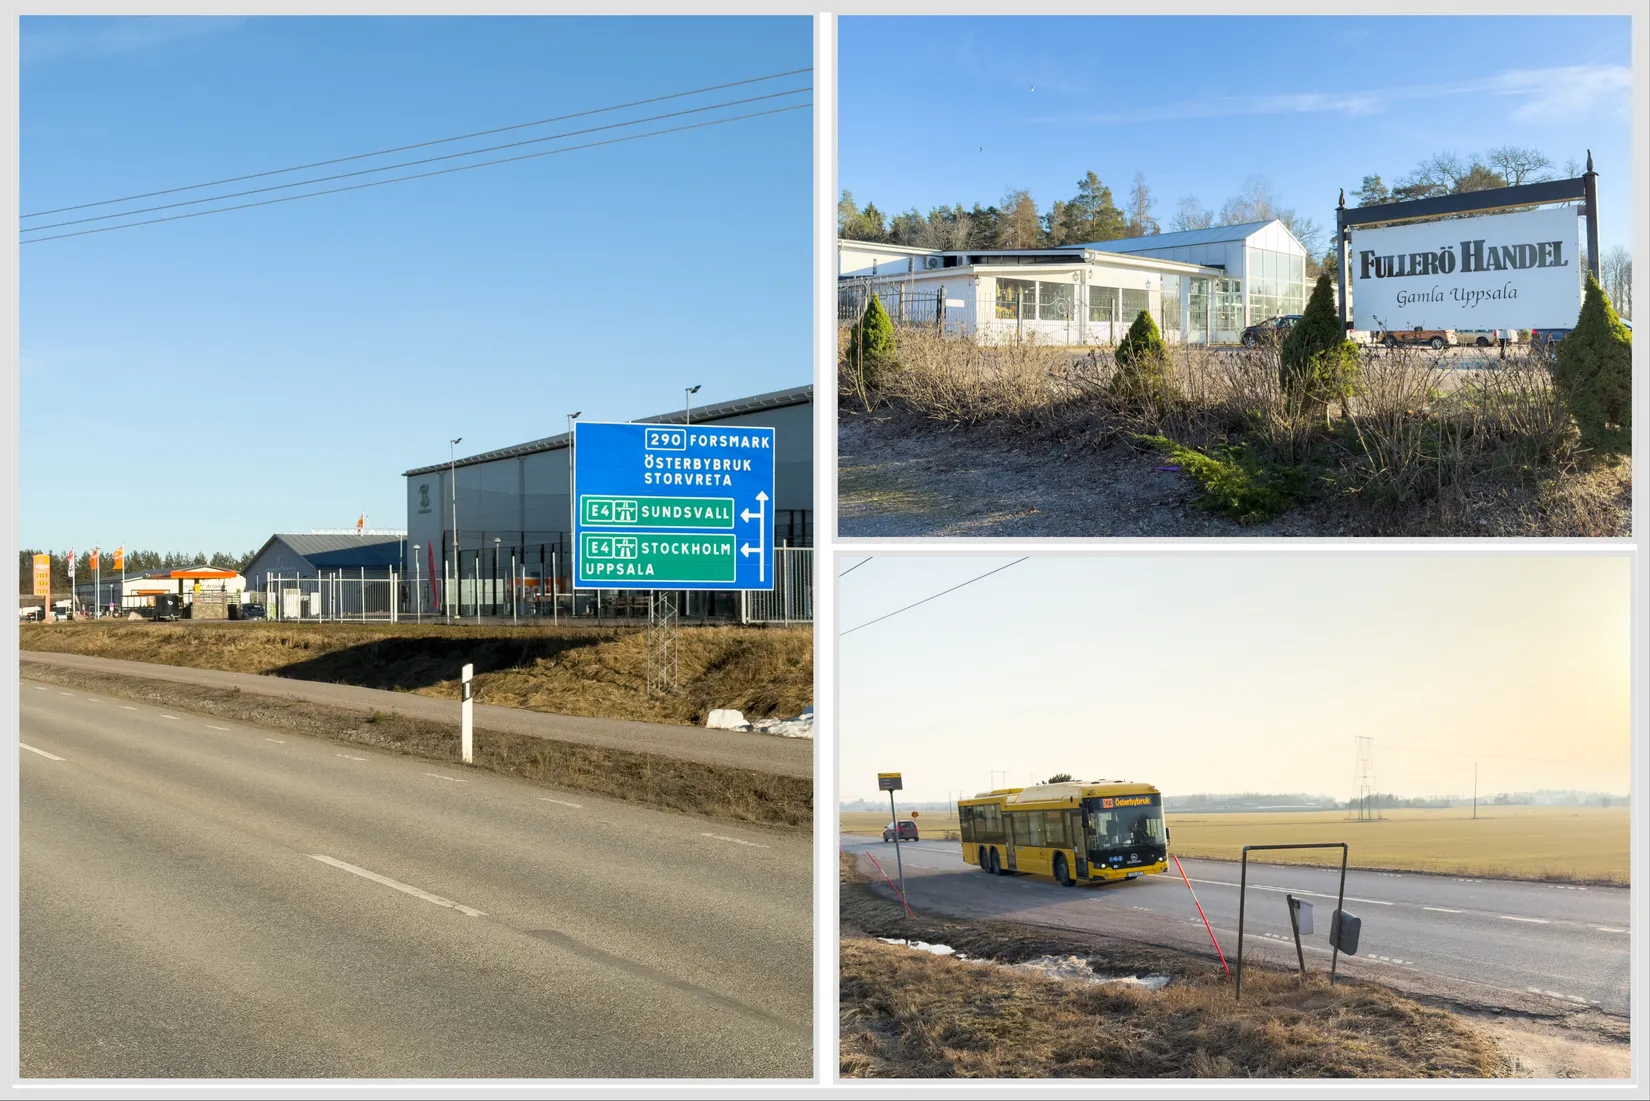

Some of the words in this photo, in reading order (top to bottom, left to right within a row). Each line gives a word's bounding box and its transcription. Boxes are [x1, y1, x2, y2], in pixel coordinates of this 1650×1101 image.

[1396, 285, 1444, 308] Gamla
[1450, 281, 1518, 308] Uppsala
[650, 433, 681, 446] 290
[689, 434, 770, 449] FORSMARK
[644, 454, 751, 471] ÖSTERBYBRUK
[644, 472, 732, 486] STORVRETA
[591, 504, 610, 517] E4
[641, 505, 730, 519] SUNDSVALL
[591, 541, 610, 554] E4
[641, 542, 731, 556] STOCKHOLM
[585, 562, 655, 576] UPPSALA
[1115, 797, 1150, 806] Österbybruk
